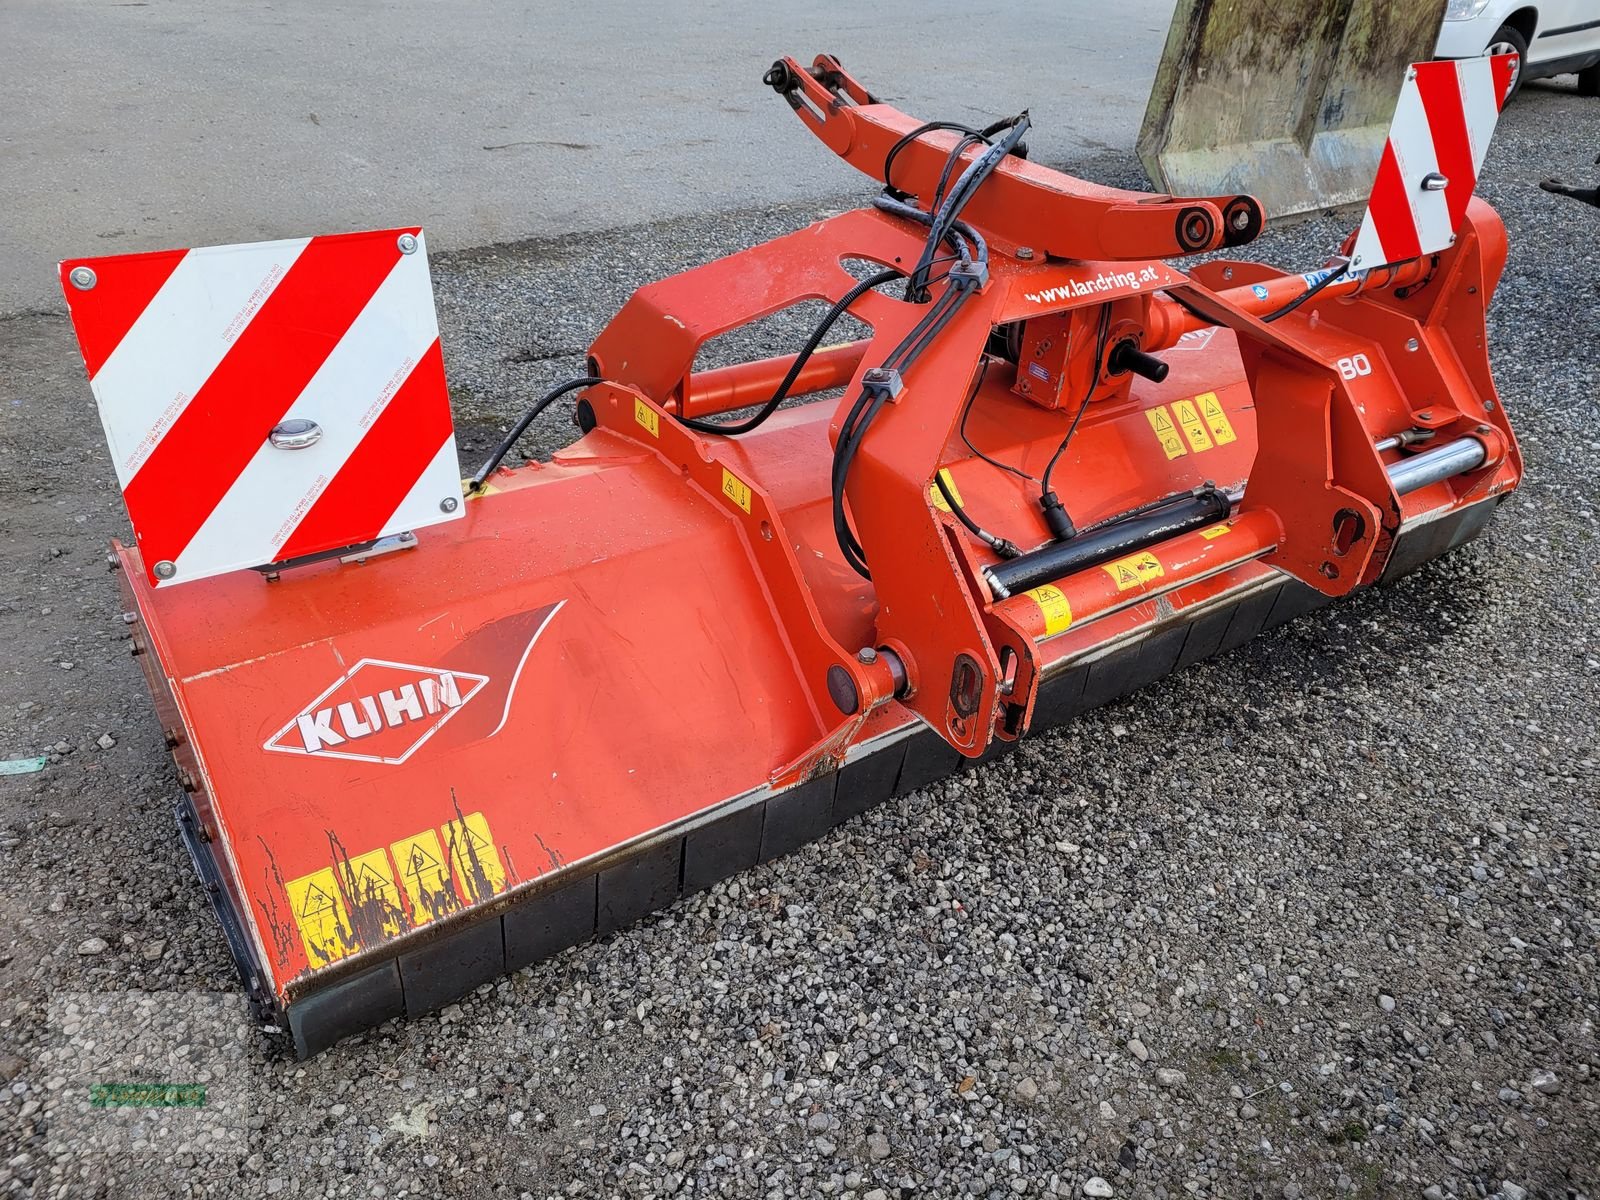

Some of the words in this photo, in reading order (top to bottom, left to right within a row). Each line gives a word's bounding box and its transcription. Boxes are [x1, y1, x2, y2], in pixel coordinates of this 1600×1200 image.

[1024, 265, 1158, 303] www.landring.at
[248, 289, 260, 304] GEKA
[245, 302, 258, 317] GEKA
[383, 380, 394, 393] GEKA
[380, 392, 391, 406] GEKA
[152, 417, 164, 433] GEKA
[149, 431, 161, 446] GEKA
[295, 498, 306, 512] GEKA
[293, 510, 304, 523] GEKA
[296, 672, 462, 753] KUHN
